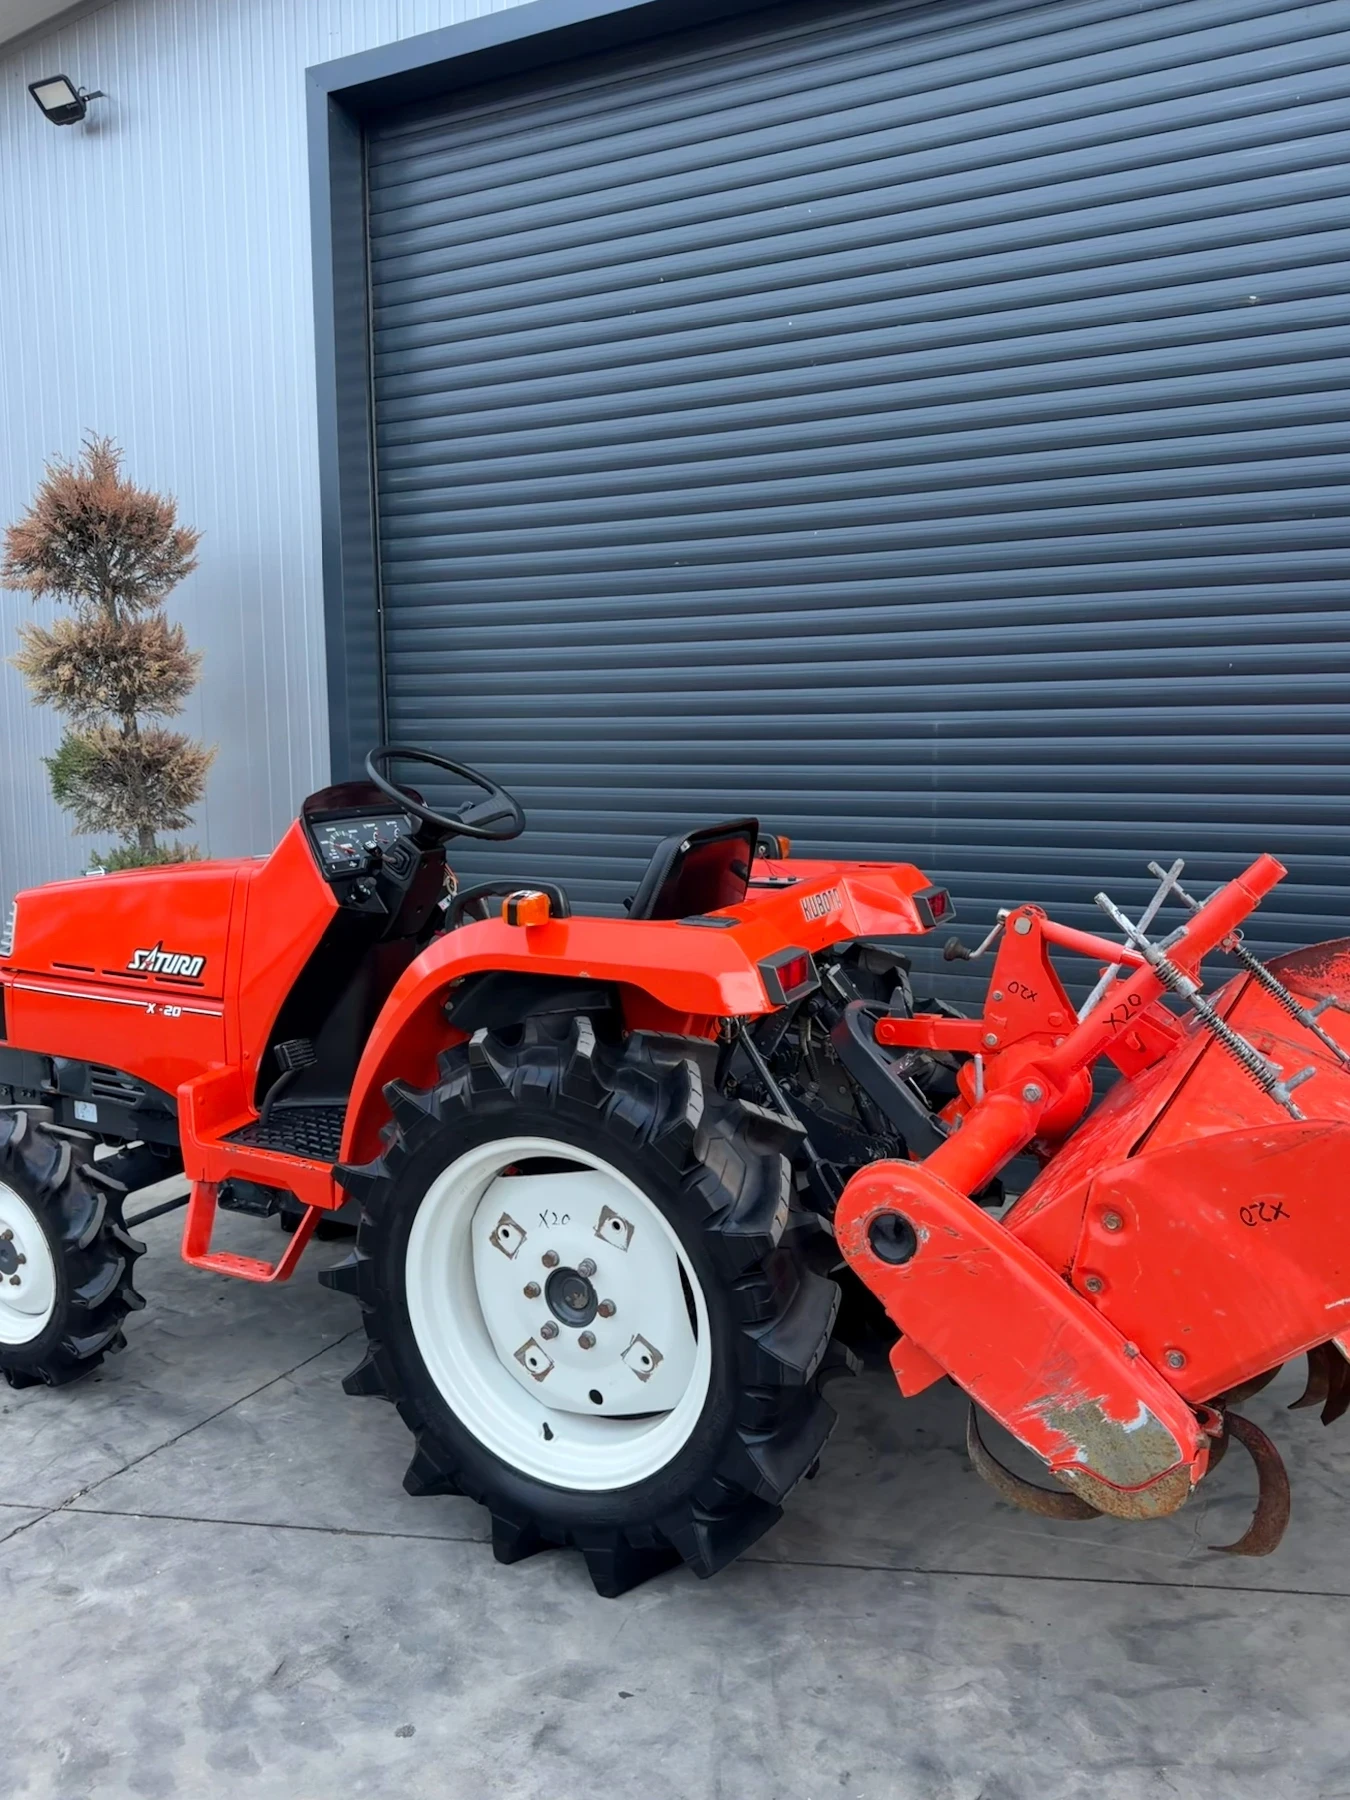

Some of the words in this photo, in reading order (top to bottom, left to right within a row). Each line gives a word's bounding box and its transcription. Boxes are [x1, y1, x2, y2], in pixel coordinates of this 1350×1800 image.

[800, 887, 842, 921] KUBOTA
[126, 941, 206, 978] SATURN
[1007, 981, 1038, 1002] X20
[1102, 993, 1142, 1034] X20
[538, 1209, 571, 1229] X20
